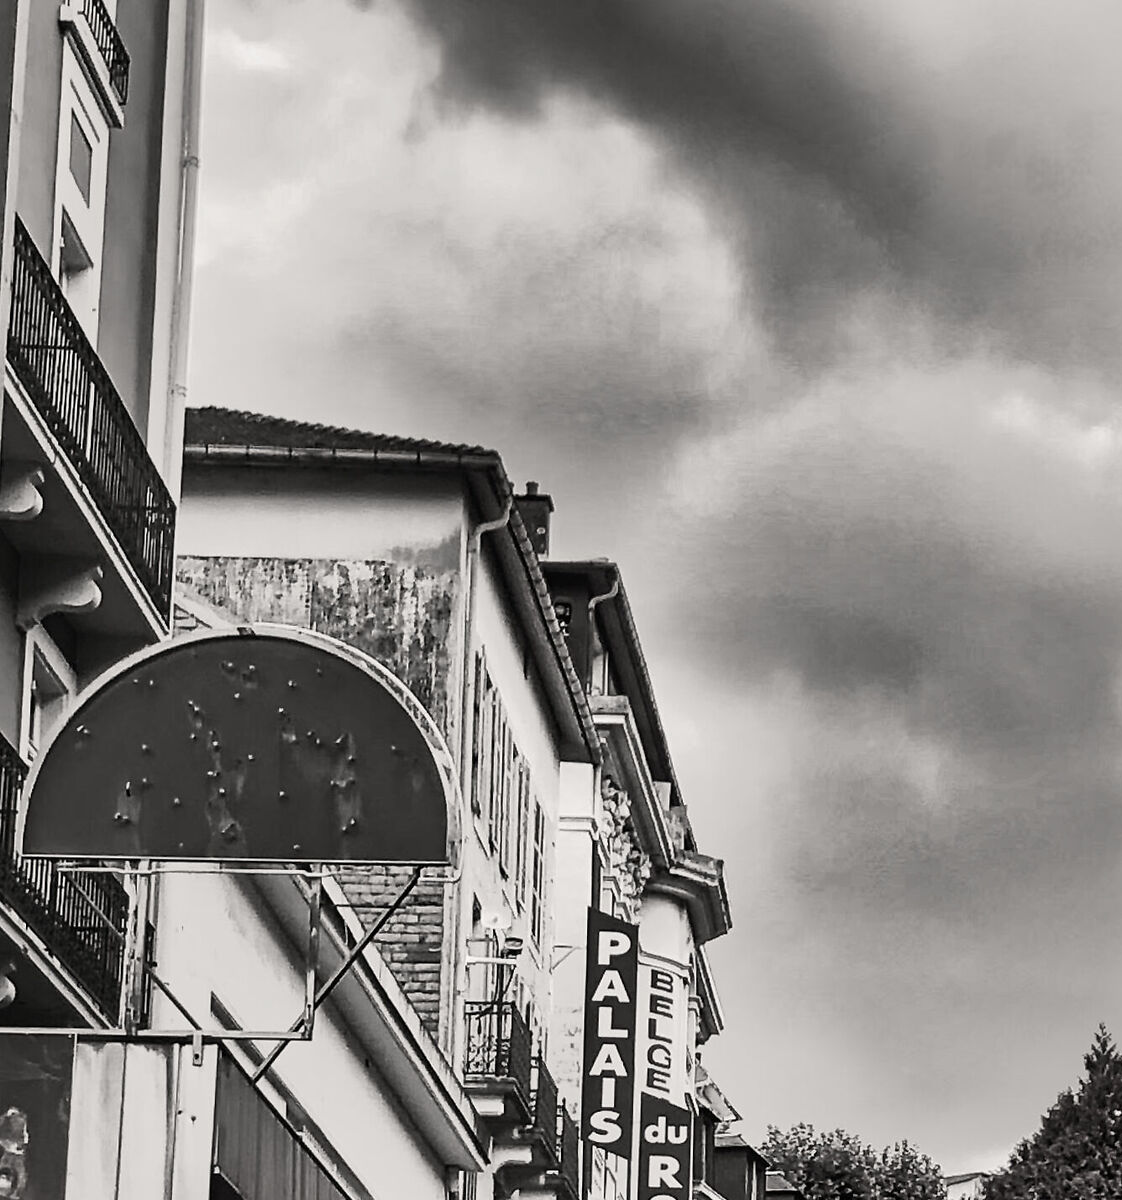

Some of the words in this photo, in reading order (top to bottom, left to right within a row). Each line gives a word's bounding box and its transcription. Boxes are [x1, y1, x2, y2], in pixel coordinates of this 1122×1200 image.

[588, 930, 632, 1144] PALAIS
[646, 968, 674, 1092] BELGE
[644, 1116, 688, 1145] du
